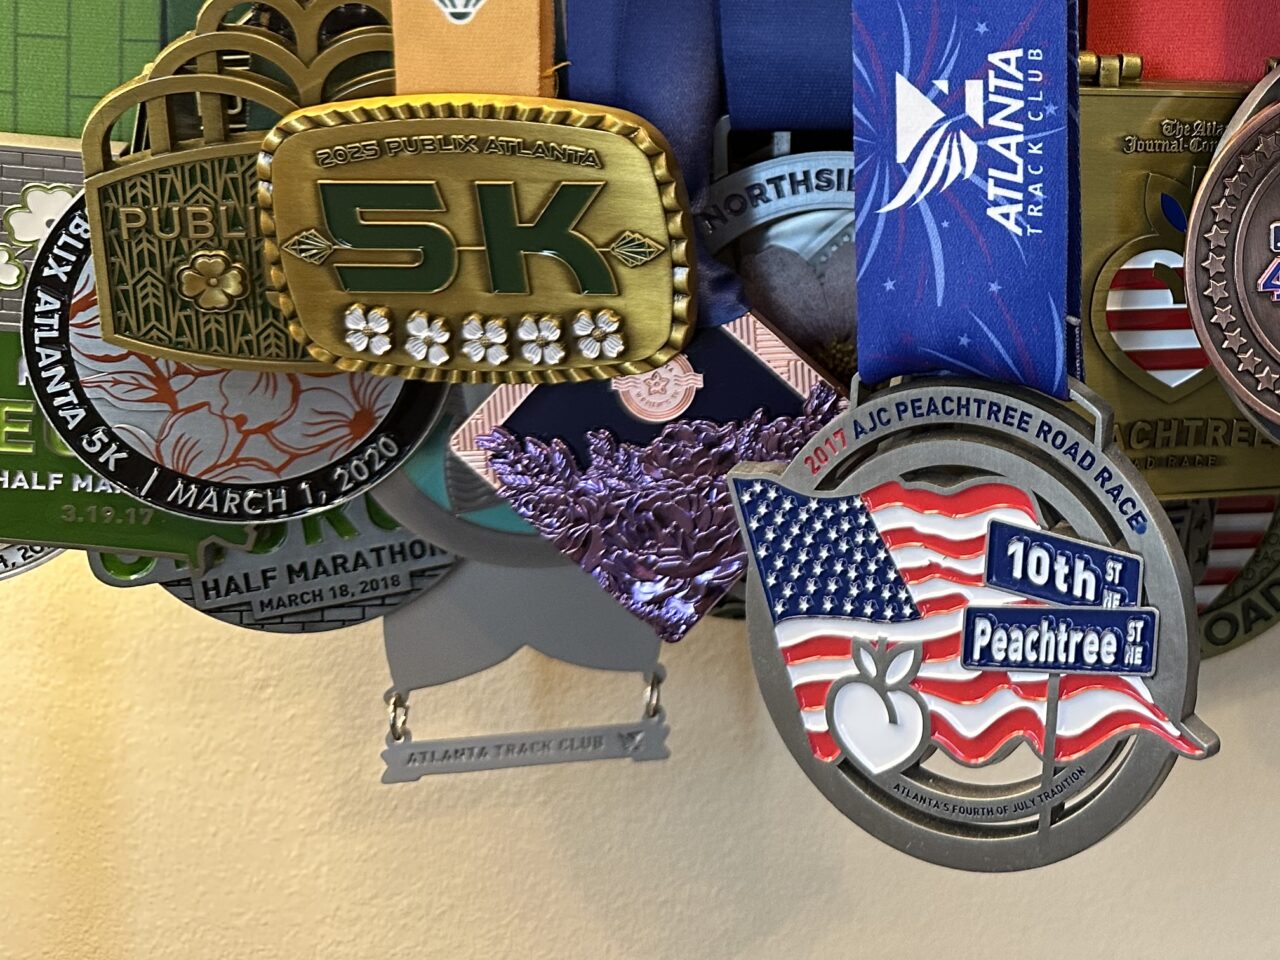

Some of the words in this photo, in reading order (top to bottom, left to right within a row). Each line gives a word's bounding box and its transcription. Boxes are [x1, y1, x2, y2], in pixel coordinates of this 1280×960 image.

[1028, 48, 1044, 121] CLUB
[316, 142, 381, 169] 2025
[384, 134, 480, 157] PUBLIX
[484, 135, 603, 169] ATLANTA
[986, 48, 1025, 236] ATLANTA
[1027, 142, 1044, 236] TRACK
[316, 180, 620, 295] 5K
[34, 290, 87, 430] ATLANTA
[82, 427, 128, 472] 5K
[167, 478, 287, 515] MARCH
[334, 436, 398, 491] 2020
[804, 428, 848, 475] 2017
[852, 407, 892, 440] AJC
[897, 395, 1034, 432] PEACHTREE
[1035, 420, 1095, 472] ROAD
[61, 504, 155, 526] 3.19.17
[202, 567, 279, 601] HALF
[260, 591, 324, 613] MARCH
[359, 575, 402, 596] 2018
[1007, 540, 1098, 601] 10th
[1105, 559, 1122, 584] ST
[973, 616, 1117, 665] Peachtree
[1124, 643, 1143, 665] NE
[1127, 619, 1145, 642] ST
[406, 746, 488, 767] ATLANTA
[493, 740, 551, 759] TRACK
[557, 735, 605, 753] CLUB
[893, 783, 950, 812] ATLANTA'S
[952, 804, 995, 817] FOURTH
[996, 805, 1010, 816] OF
[1013, 799, 1036, 813] JULY
[1037, 766, 1086, 806] TRADITION
